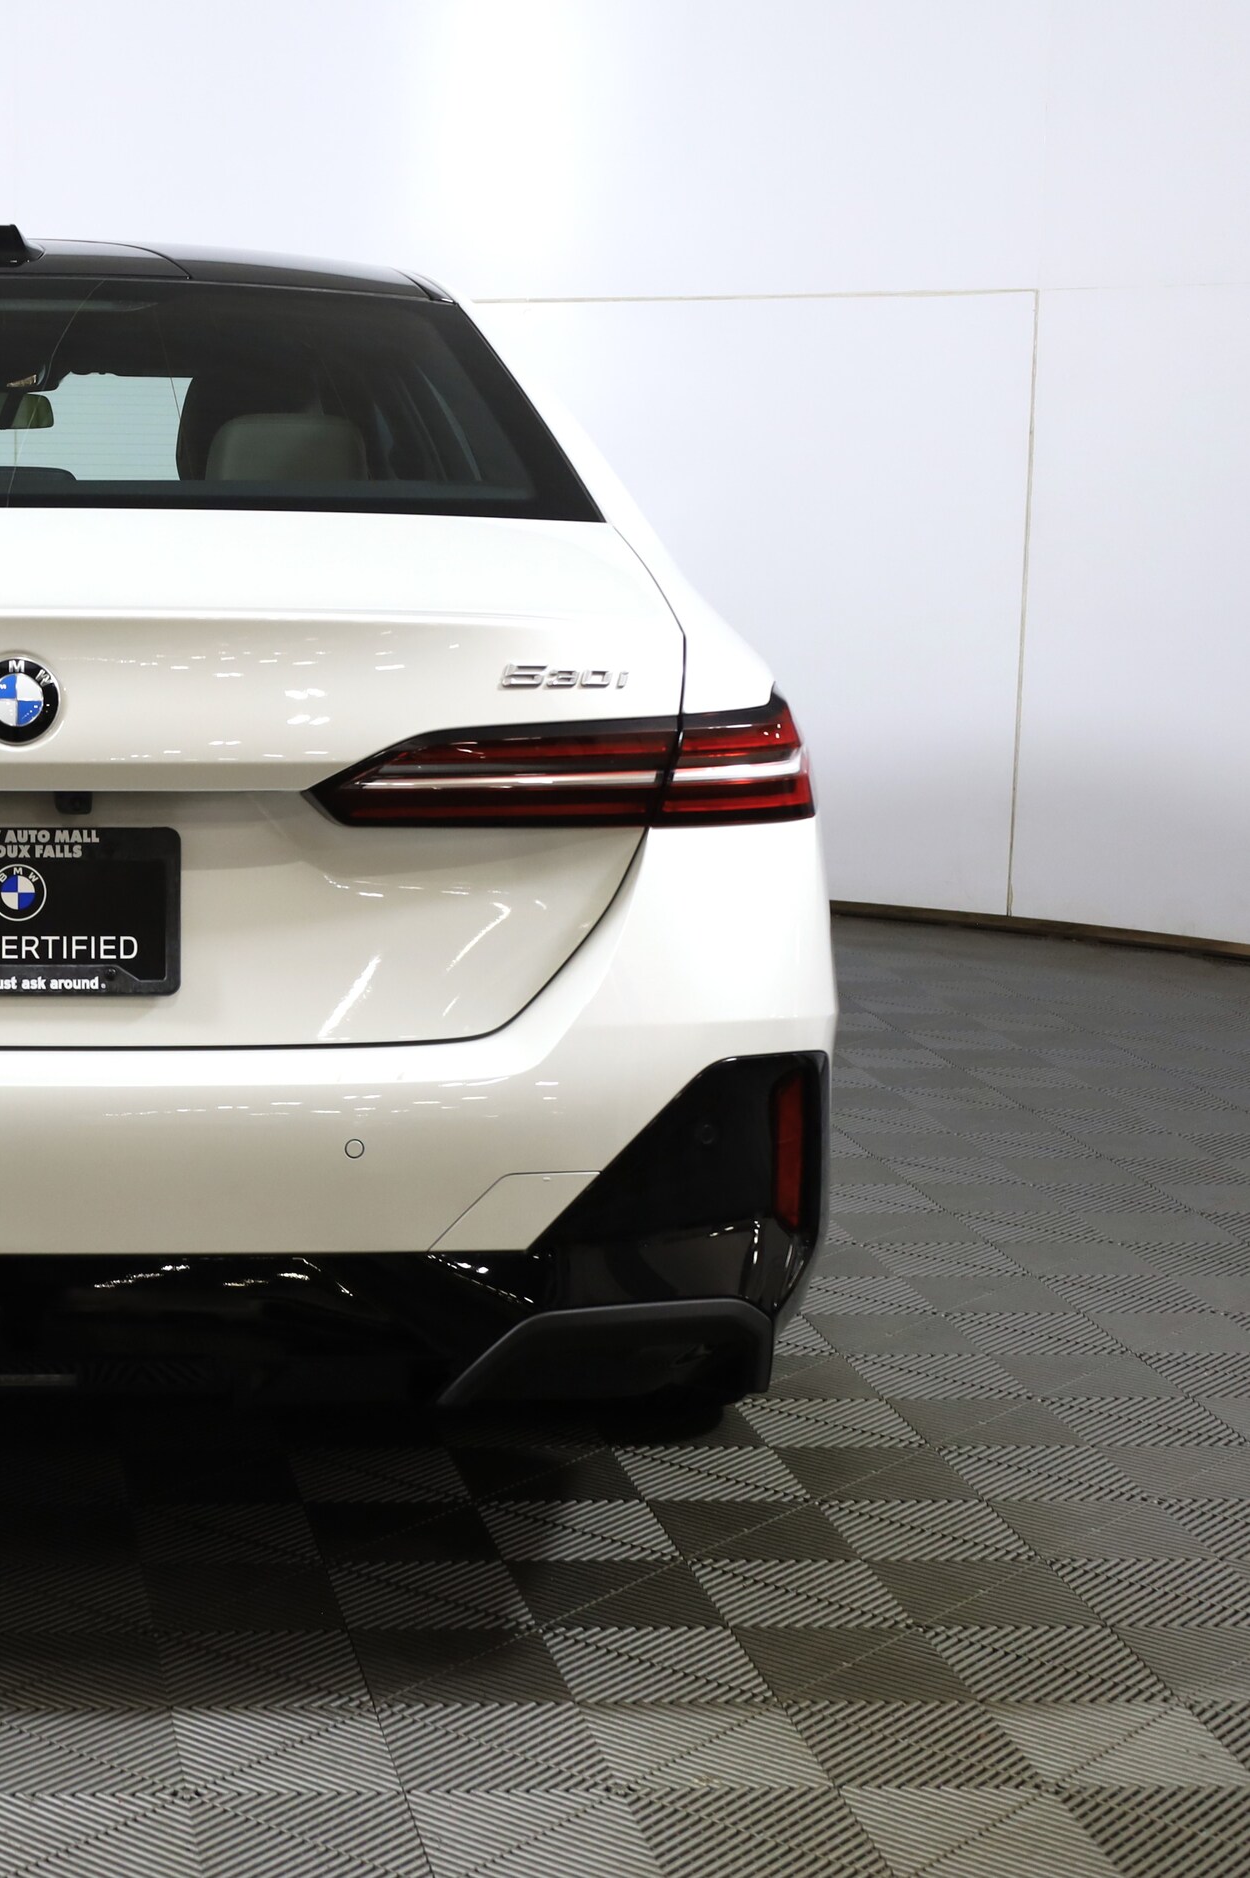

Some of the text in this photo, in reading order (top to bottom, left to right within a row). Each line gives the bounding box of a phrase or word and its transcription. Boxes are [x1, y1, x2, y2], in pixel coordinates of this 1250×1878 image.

[500, 662, 630, 690] 530i
[4, 829, 51, 844] AUTO
[54, 829, 100, 844] MALL
[34, 844, 83, 859] FALLS
[20, 975, 47, 991] ask
